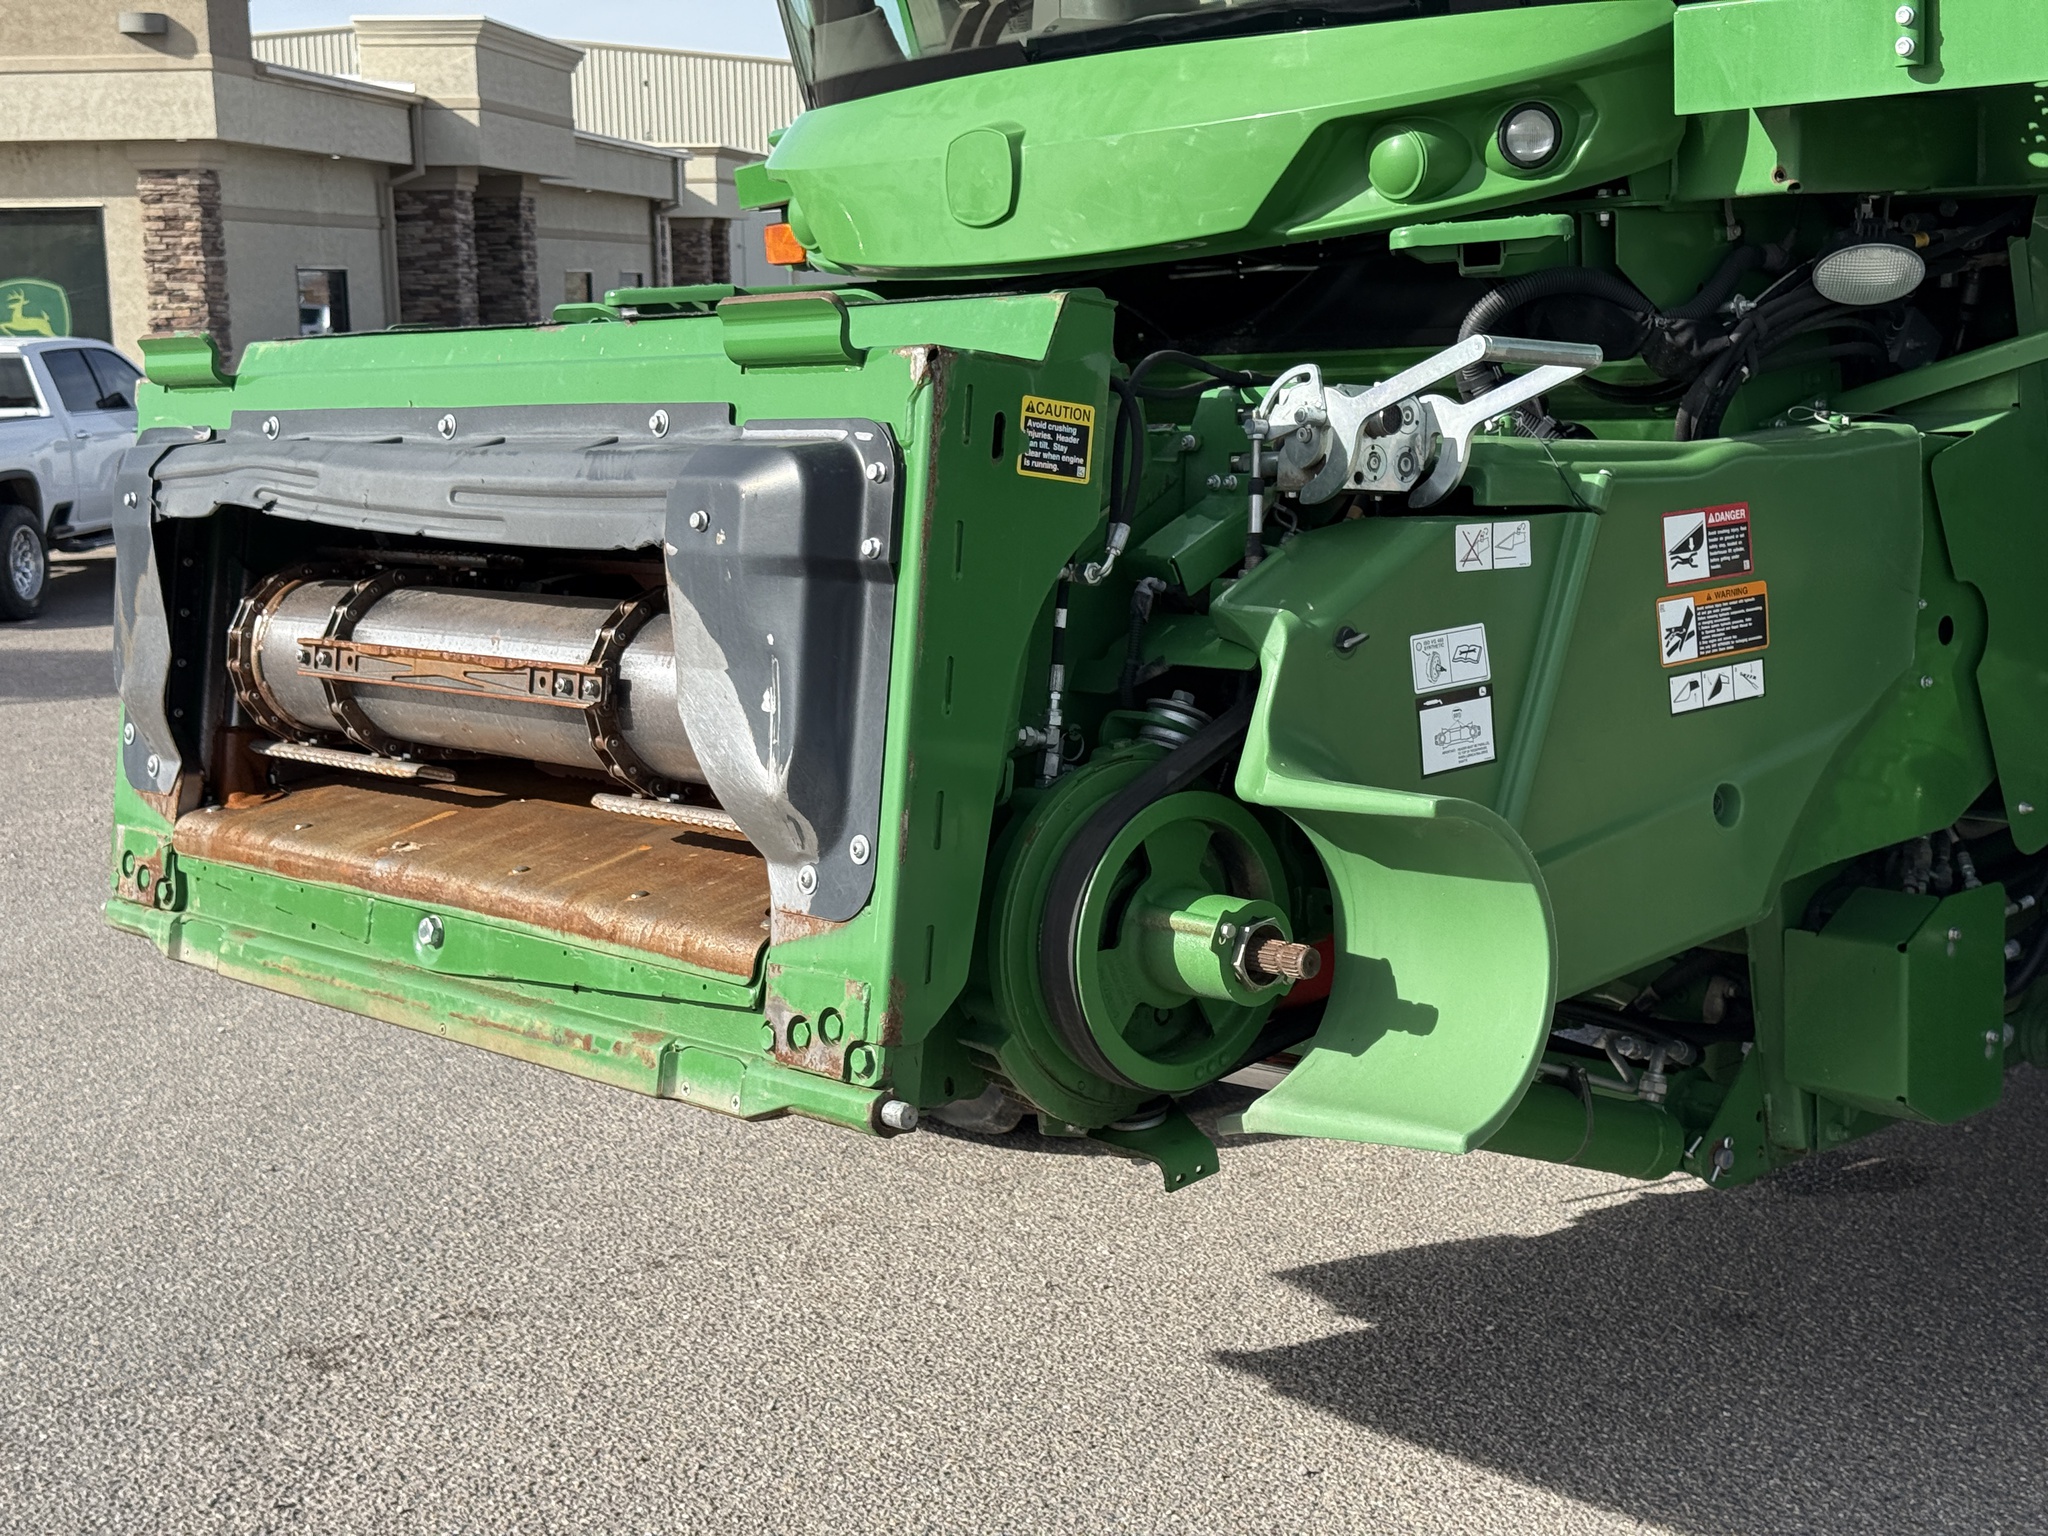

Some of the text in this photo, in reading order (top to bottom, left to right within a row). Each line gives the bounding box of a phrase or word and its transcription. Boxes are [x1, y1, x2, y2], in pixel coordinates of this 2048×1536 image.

[1036, 402, 1091, 422] CAUTION
[1027, 418, 1078, 436] Avoid crushing
[1056, 433, 1080, 444] Header
[1029, 440, 1068, 454] an tilt. Stay
[1023, 457, 1060, 472] is running.
[1042, 451, 1061, 461] when
[1061, 455, 1084, 465] engine
[1714, 508, 1746, 523] DANGER
[1714, 586, 1748, 599] WARNING
